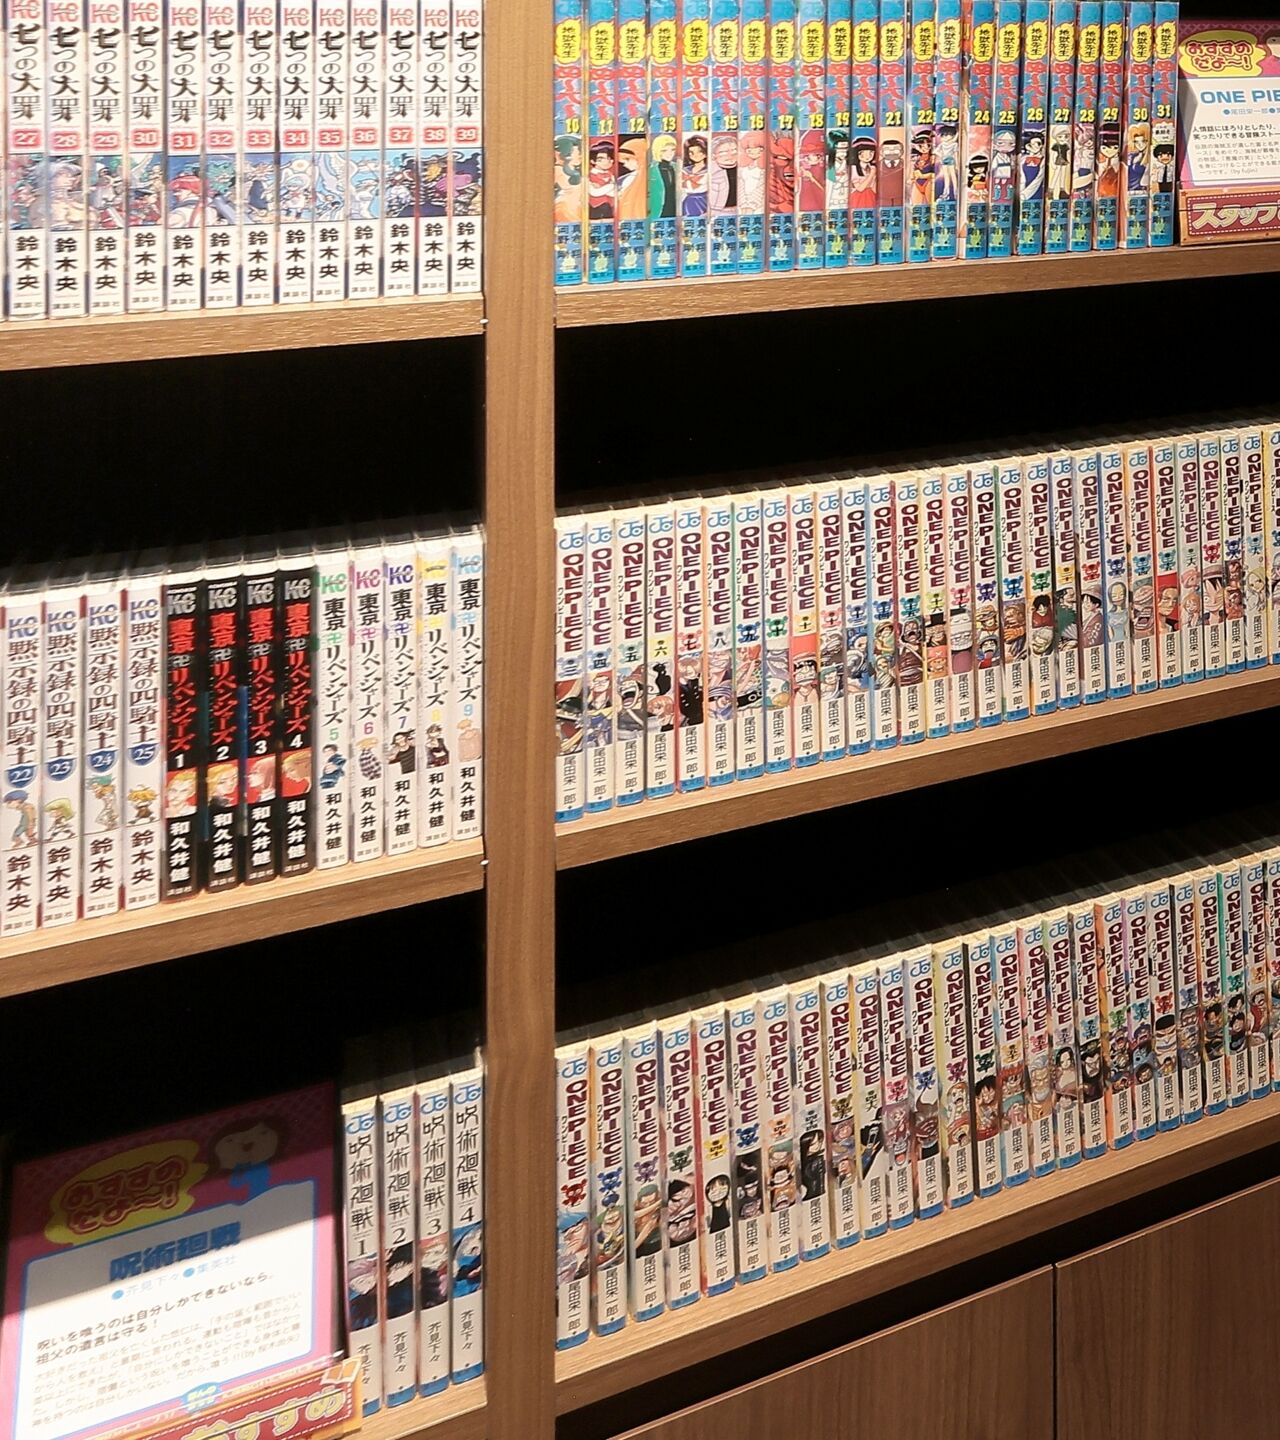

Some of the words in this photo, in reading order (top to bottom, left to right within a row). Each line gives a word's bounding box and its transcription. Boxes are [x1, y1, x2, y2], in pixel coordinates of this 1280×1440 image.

[626, 26, 639, 59] 地獄先生
[690, 25, 703, 58] 地獄先生
[11, 24, 42, 122] 七つの大罪
[91, 28, 121, 123] 七つの大罪
[171, 30, 201, 123] 七つの大罪
[246, 29, 276, 122] 七つの大罪
[318, 30, 346, 121] 七つの大罪
[389, 30, 416, 119] 七つの大罪
[456, 30, 482, 117] 七つの大罪
[1157, 104, 1172, 119] 31
[1201, 90, 1245, 104] ONE
[630, 117, 645, 132] 12
[692, 115, 707, 131] 14
[856, 112, 874, 127] 20
[942, 107, 958, 122] 23
[999, 110, 1017, 125] 25
[14, 131, 41, 146] 27
[55, 133, 78, 148] 28
[94, 132, 119, 147] 29
[134, 130, 158, 145] 30
[173, 135, 196, 148] 31
[249, 132, 271, 146] 33
[284, 131, 307, 146] 34
[320, 131, 341, 145] 35
[391, 130, 412, 143] 37
[425, 128, 446, 142] 38
[456, 128, 478, 141] 39
[16, 235, 39, 291] 鈴木央
[456, 222, 475, 271] 鈴木央
[284, 602, 312, 737] 東京卍リベンジャーズ
[323, 598, 348, 728] 東京卍リベンジャーズ
[391, 590, 414, 716] 東京卍リベンジャーズ
[46, 633, 75, 758] 黙示録の四騎士
[129, 619, 158, 743] 黙示録の四騎士
[169, 618, 196, 750] 東京卍リベンジャーズ
[209, 612, 238, 747] 東京卍リベンジャーズ
[6, 641, 37, 765] 黙示録の四騎士
[463, 701, 473, 717] 9
[329, 728, 339, 741] 5
[363, 721, 374, 735] 6
[398, 715, 408, 730] 7
[134, 747, 154, 762] 25
[216, 746, 229, 761] 2
[255, 740, 268, 754] 3
[290, 736, 302, 749] 4
[685, 727, 698, 774] 尾田栄一郎
[11, 769, 34, 784] 22
[51, 761, 72, 777] 23
[92, 754, 113, 769] 24
[624, 741, 637, 788] 尾田栄一郎
[461, 765, 476, 822] 和久井健
[325, 791, 342, 850] 和久井健
[130, 830, 154, 884] 鈴木央
[170, 822, 191, 882] 和久井健
[213, 814, 233, 874] 和久井健
[6, 855, 32, 912] 鈴木央
[386, 1120, 410, 1217] 呪術廻戦
[423, 1113, 446, 1209] 呪術廻戦
[456, 1104, 480, 1200] 呪術廻戦
[349, 1133, 374, 1228] 呪術廻戦
[427, 1218, 441, 1235] 3
[460, 1205, 475, 1224] 4
[109, 1221, 241, 1283] 呪術廻戦
[392, 1227, 406, 1245] 2
[460, 1309, 473, 1351] 芥見下々
